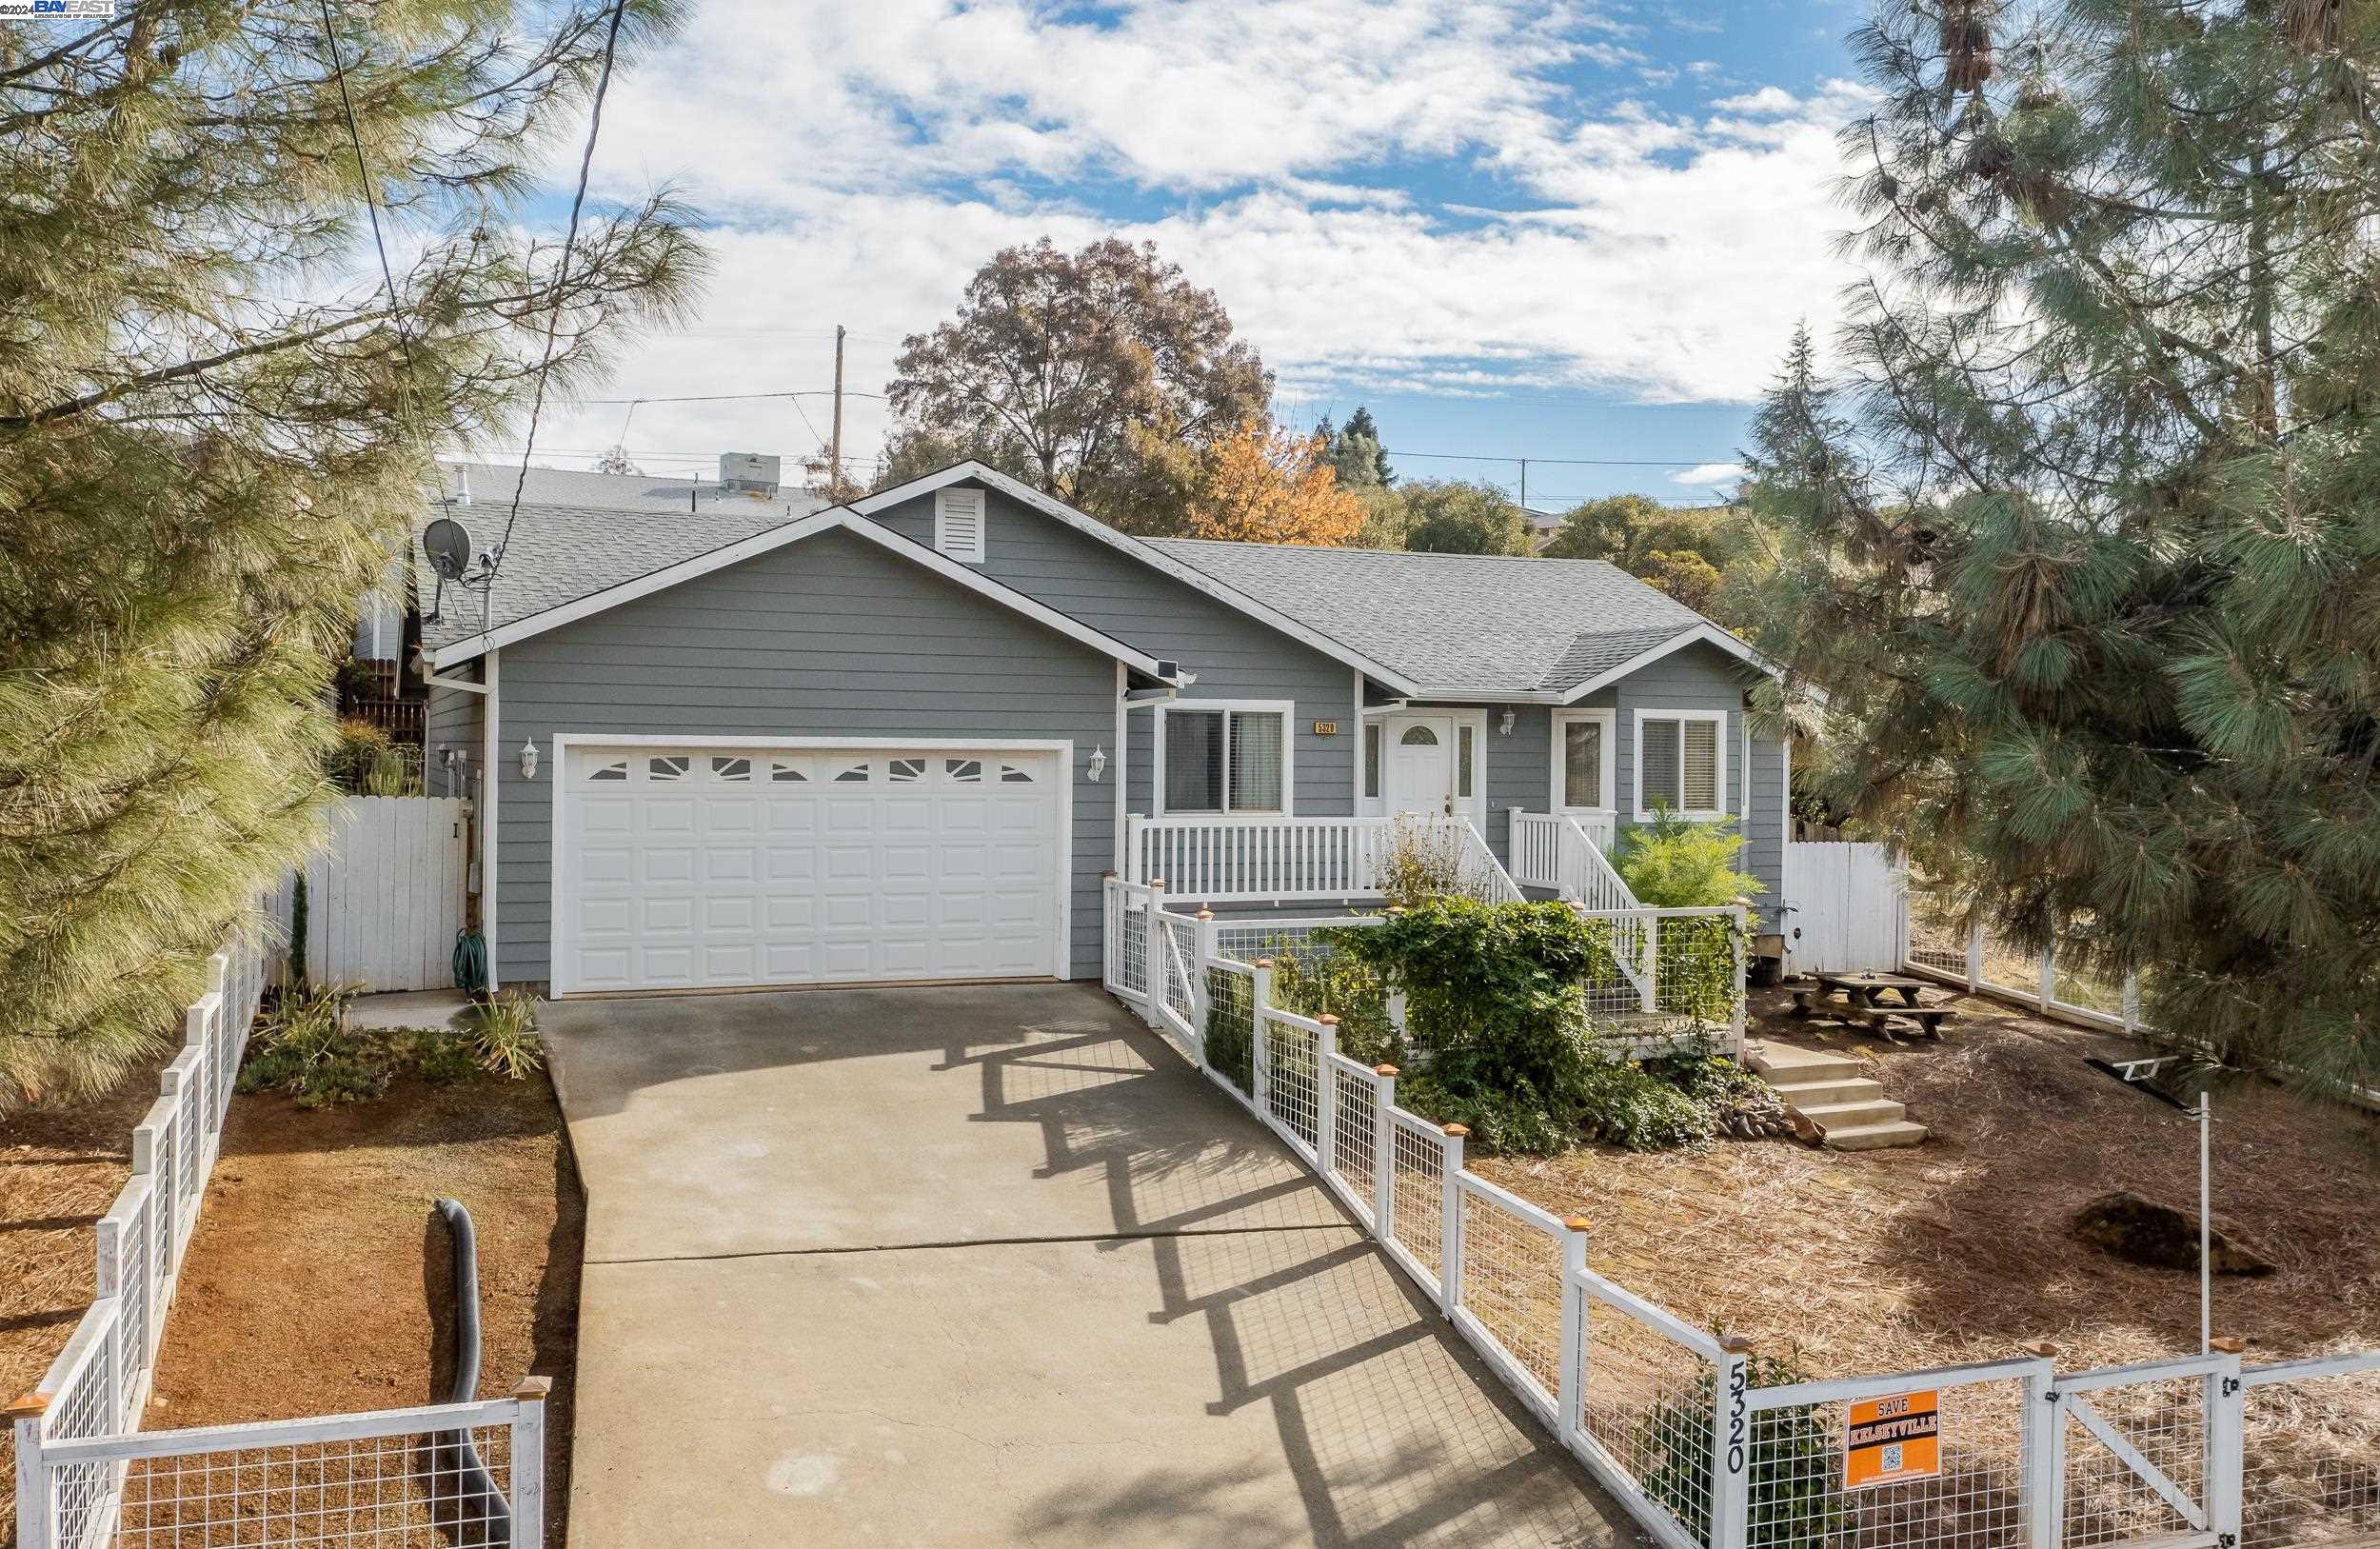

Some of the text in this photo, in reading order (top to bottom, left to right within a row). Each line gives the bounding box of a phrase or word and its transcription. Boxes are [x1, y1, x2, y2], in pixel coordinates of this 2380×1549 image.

[1318, 723, 1335, 733] 5320
[1727, 1360, 1746, 1474] 5320
[1878, 1399, 1909, 1417] SAVE
[1850, 1415, 1937, 1445] KELSEYVILLE
